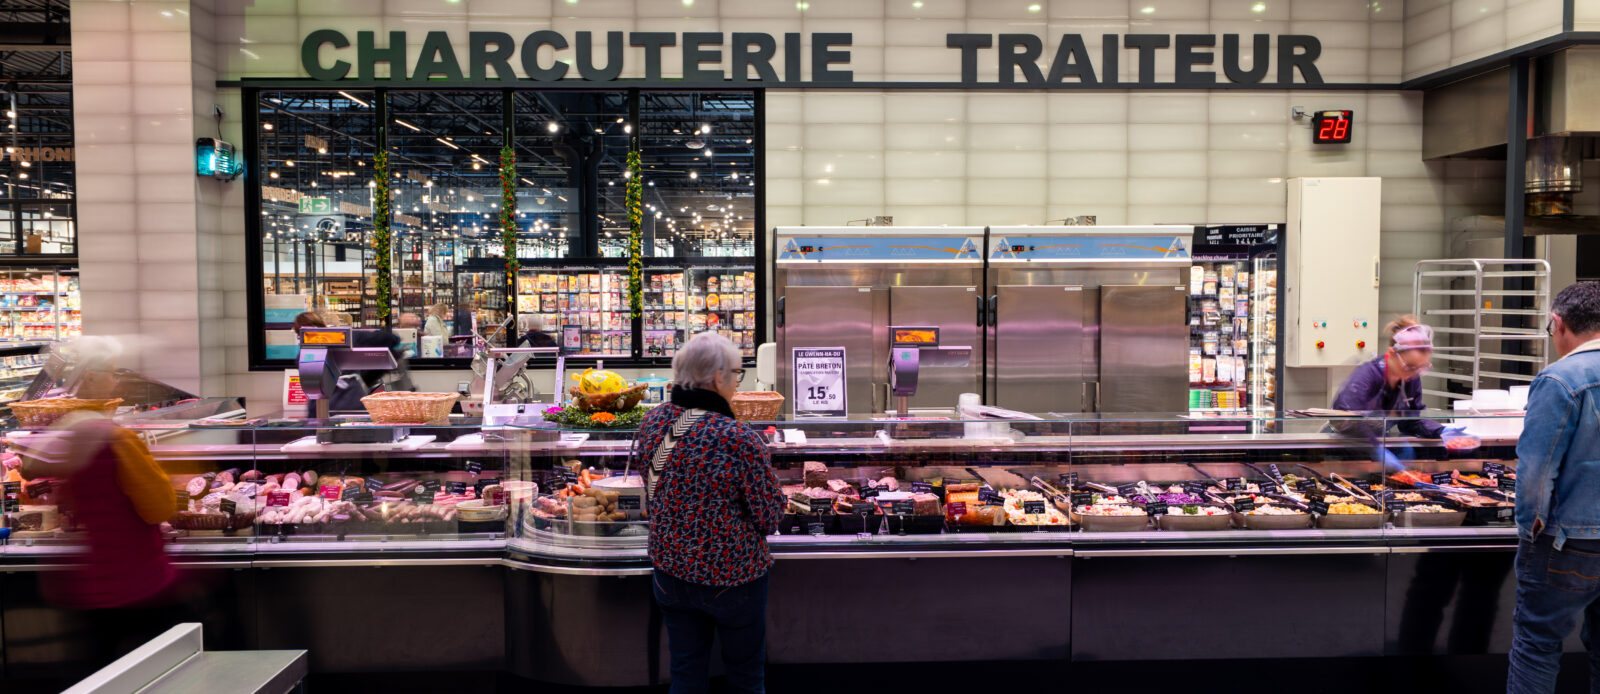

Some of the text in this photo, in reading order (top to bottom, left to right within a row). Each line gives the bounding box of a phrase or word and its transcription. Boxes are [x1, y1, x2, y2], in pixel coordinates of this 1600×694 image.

[300, 29, 1325, 84] CHARCUTERIE TRAITEUR
[1319, 119, 1349, 140] 28
